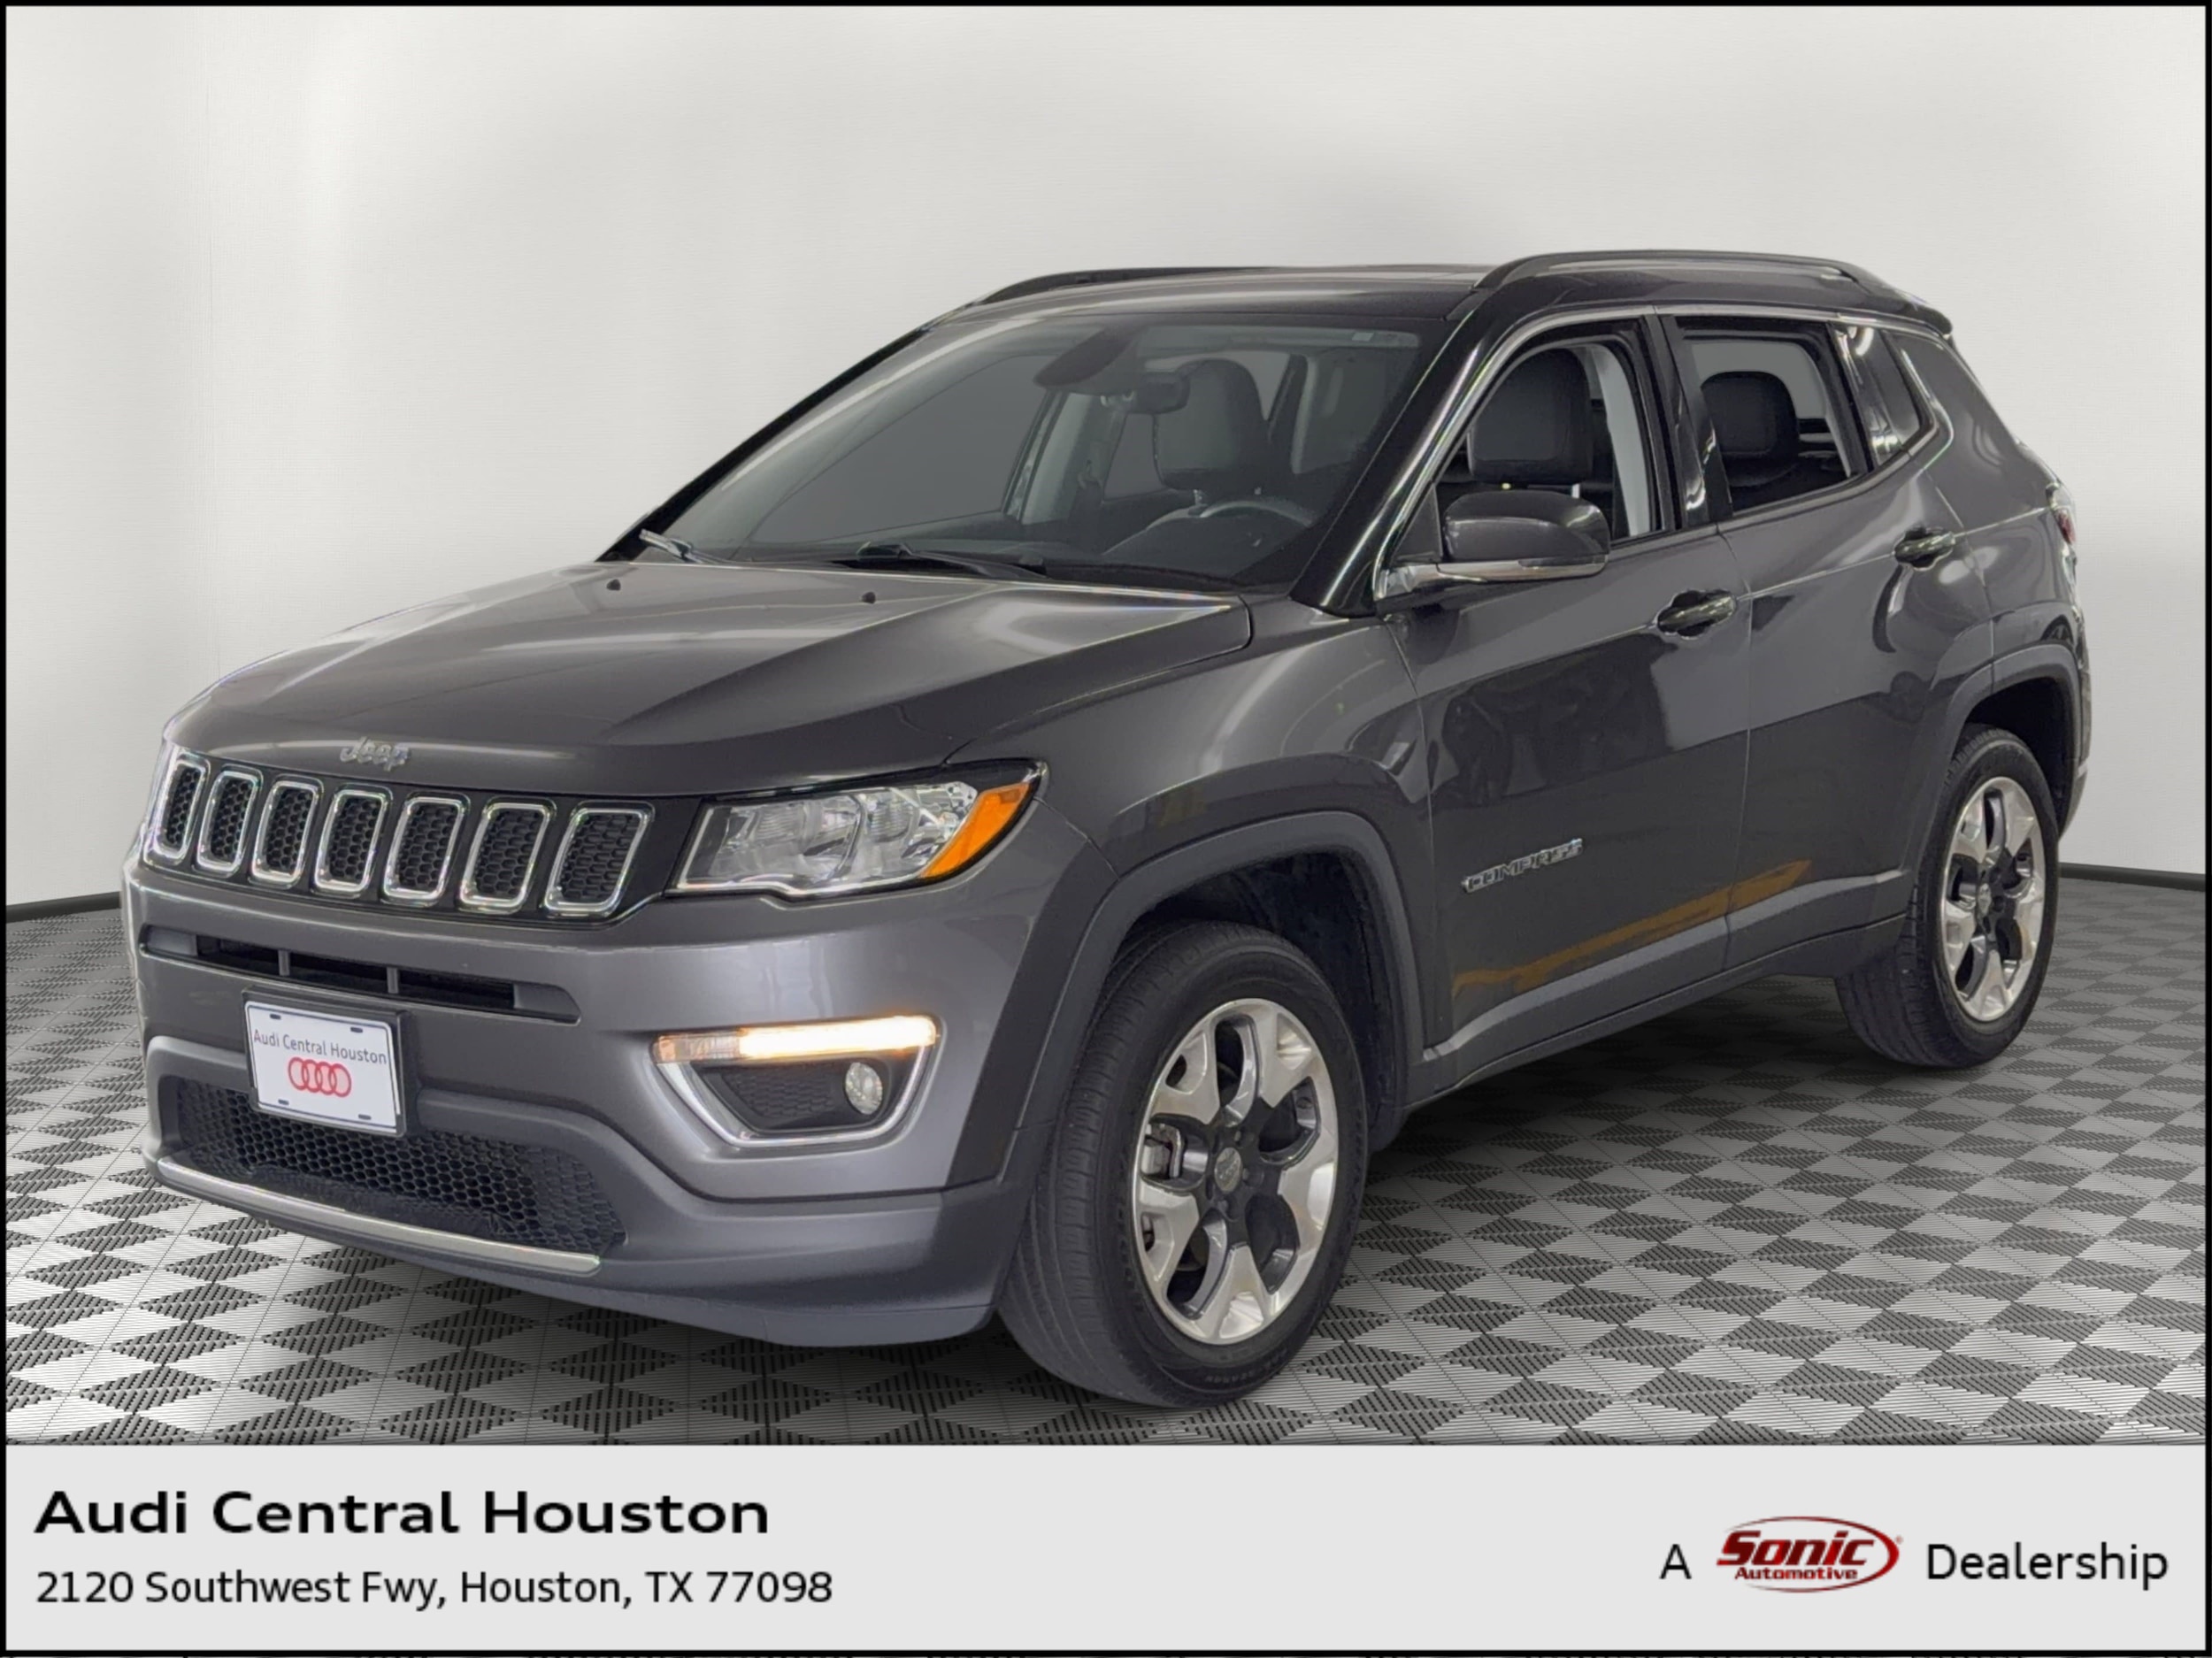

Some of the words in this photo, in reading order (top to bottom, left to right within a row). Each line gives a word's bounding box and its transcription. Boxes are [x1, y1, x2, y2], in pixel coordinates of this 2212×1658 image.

[340, 736, 410, 771] Jeep
[253, 1029, 280, 1048] Audi
[282, 1033, 327, 1056] Central
[330, 1042, 388, 1065] Houston
